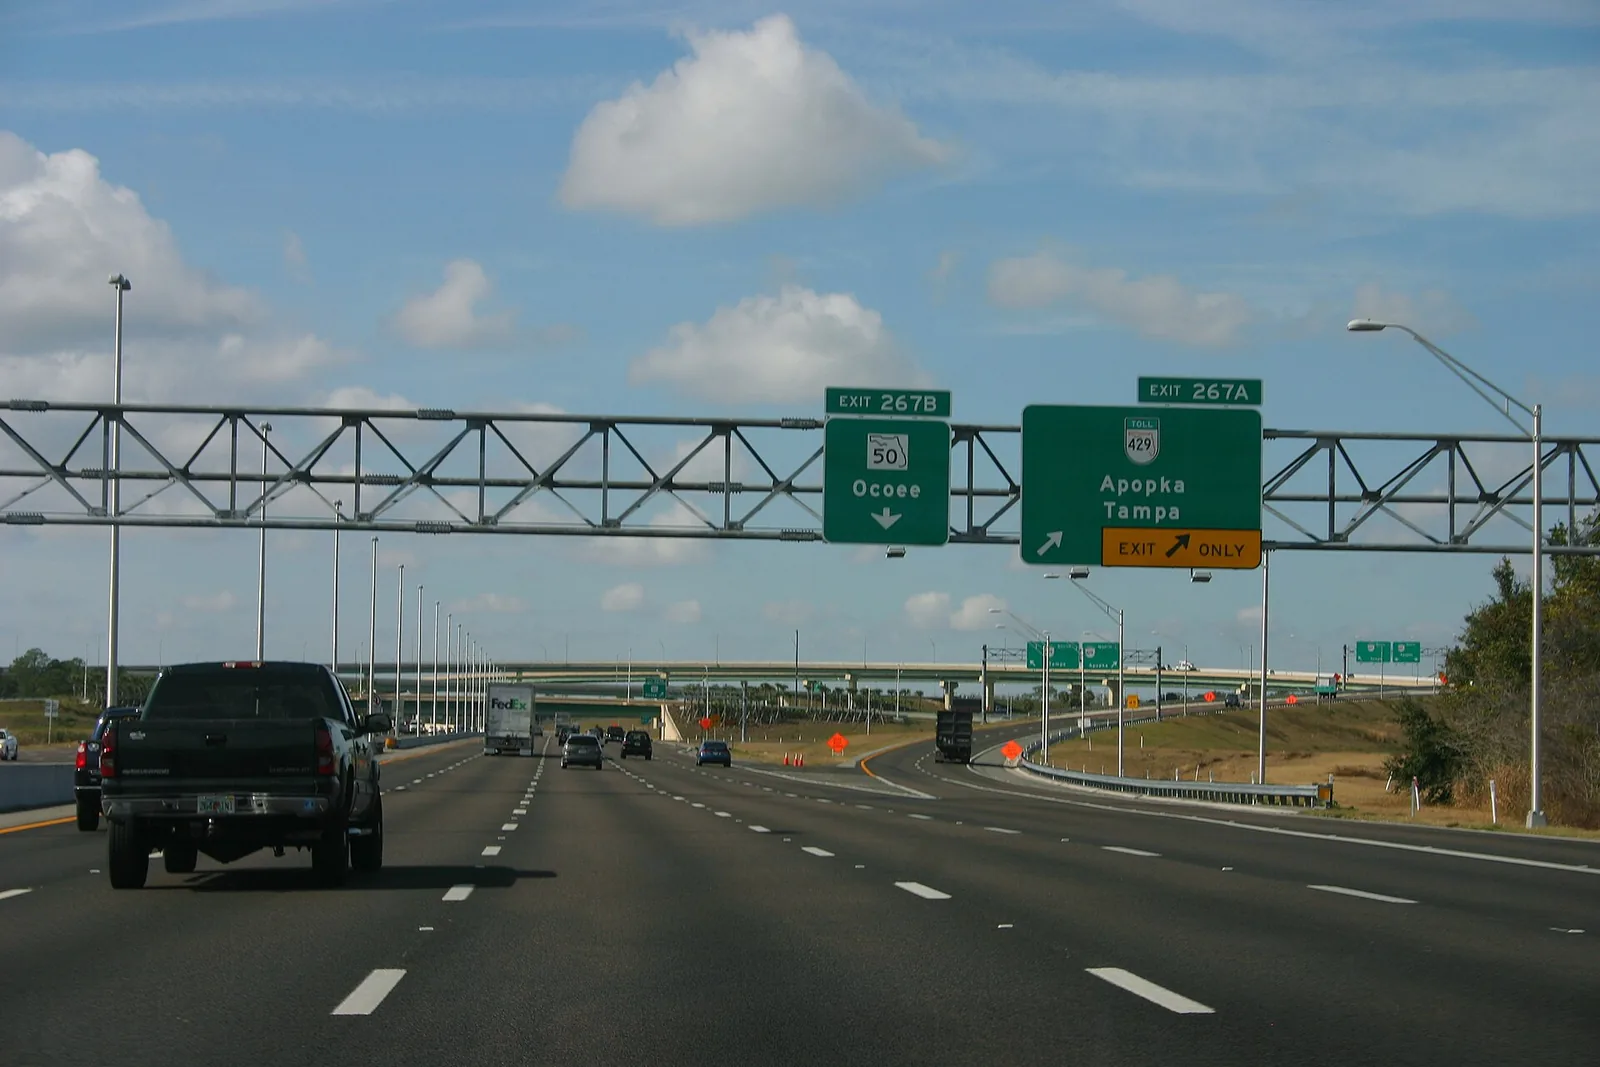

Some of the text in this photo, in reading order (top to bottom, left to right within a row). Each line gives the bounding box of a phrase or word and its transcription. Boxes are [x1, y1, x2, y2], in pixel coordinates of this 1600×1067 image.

[1150, 383, 1249, 401] EXIT 267A
[839, 395, 938, 412] EXIT 267B
[1131, 420, 1154, 429] TOLL
[1127, 437, 1152, 452] 429
[873, 448, 898, 465] 50
[852, 480, 921, 499] Ocoee
[1100, 475, 1186, 496] Apopka
[1104, 502, 1181, 523] Tampa
[1119, 542, 1246, 558] EXIT ONLY
[491, 697, 527, 710] FedEx
